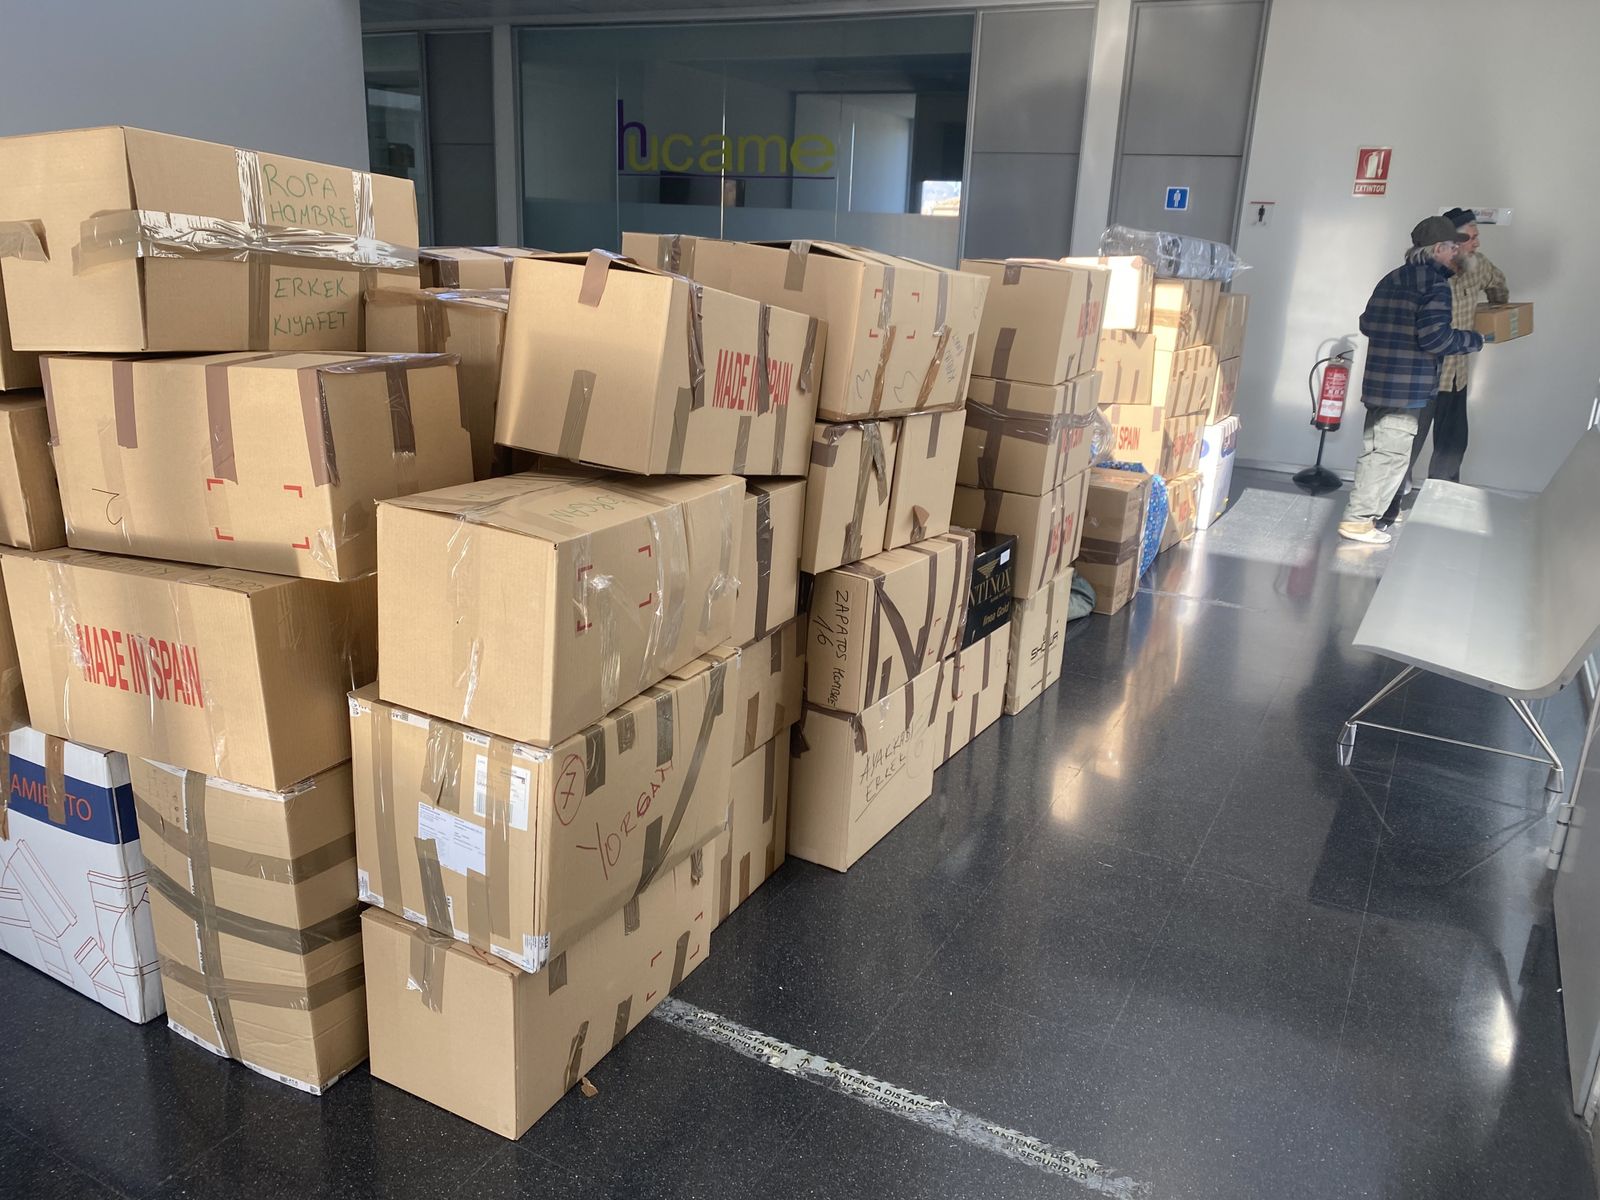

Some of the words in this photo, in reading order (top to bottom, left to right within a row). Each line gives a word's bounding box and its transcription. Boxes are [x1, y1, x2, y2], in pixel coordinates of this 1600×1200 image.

[618, 99, 836, 173] hucame
[263, 163, 337, 199] ROPA
[270, 200, 354, 228] HOMBRE
[274, 276, 349, 298] ERKEK
[273, 310, 349, 337] KIYAFET
[712, 348, 751, 411] MADE
[767, 356, 794, 414] PAIN
[1118, 426, 1141, 450] SPAIN
[834, 589, 850, 662] ZAPATOS
[76, 623, 129, 691] MADE
[126, 632, 151, 697] IN
[149, 636, 204, 708] SPAIN
[10, 773, 93, 821] AMIETO
[560, 771, 577, 810] 7
